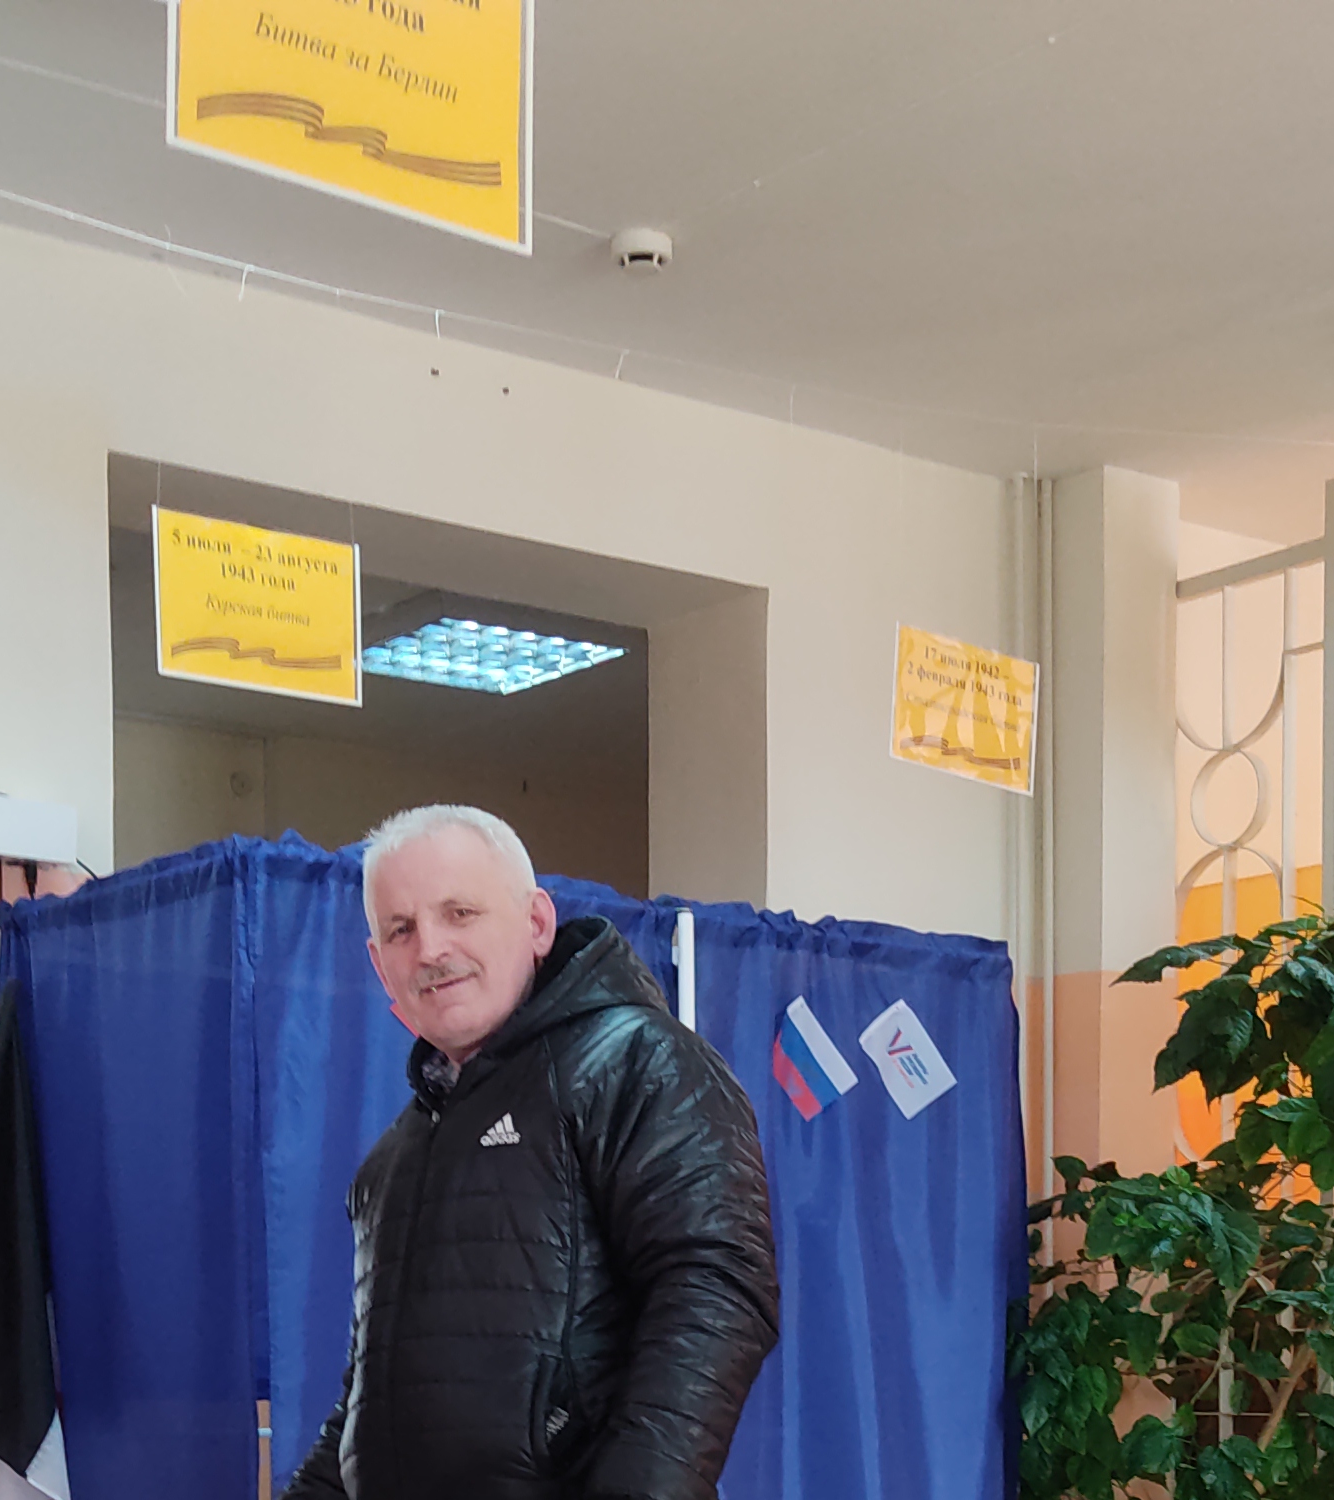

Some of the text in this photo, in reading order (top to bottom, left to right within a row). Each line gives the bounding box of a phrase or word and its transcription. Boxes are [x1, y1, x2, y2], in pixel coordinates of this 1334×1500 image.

[255, 11, 458, 104] Битва за Берлин
[171, 528, 182, 545] 5
[186, 532, 232, 554] июля
[255, 543, 273, 563] 23
[277, 548, 339, 577] августа
[220, 561, 256, 583] 1943
[205, 592, 264, 618] Курская
[907, 661, 914, 676] 2
[924, 645, 937, 660] 17
[975, 659, 1001, 681] 1942
